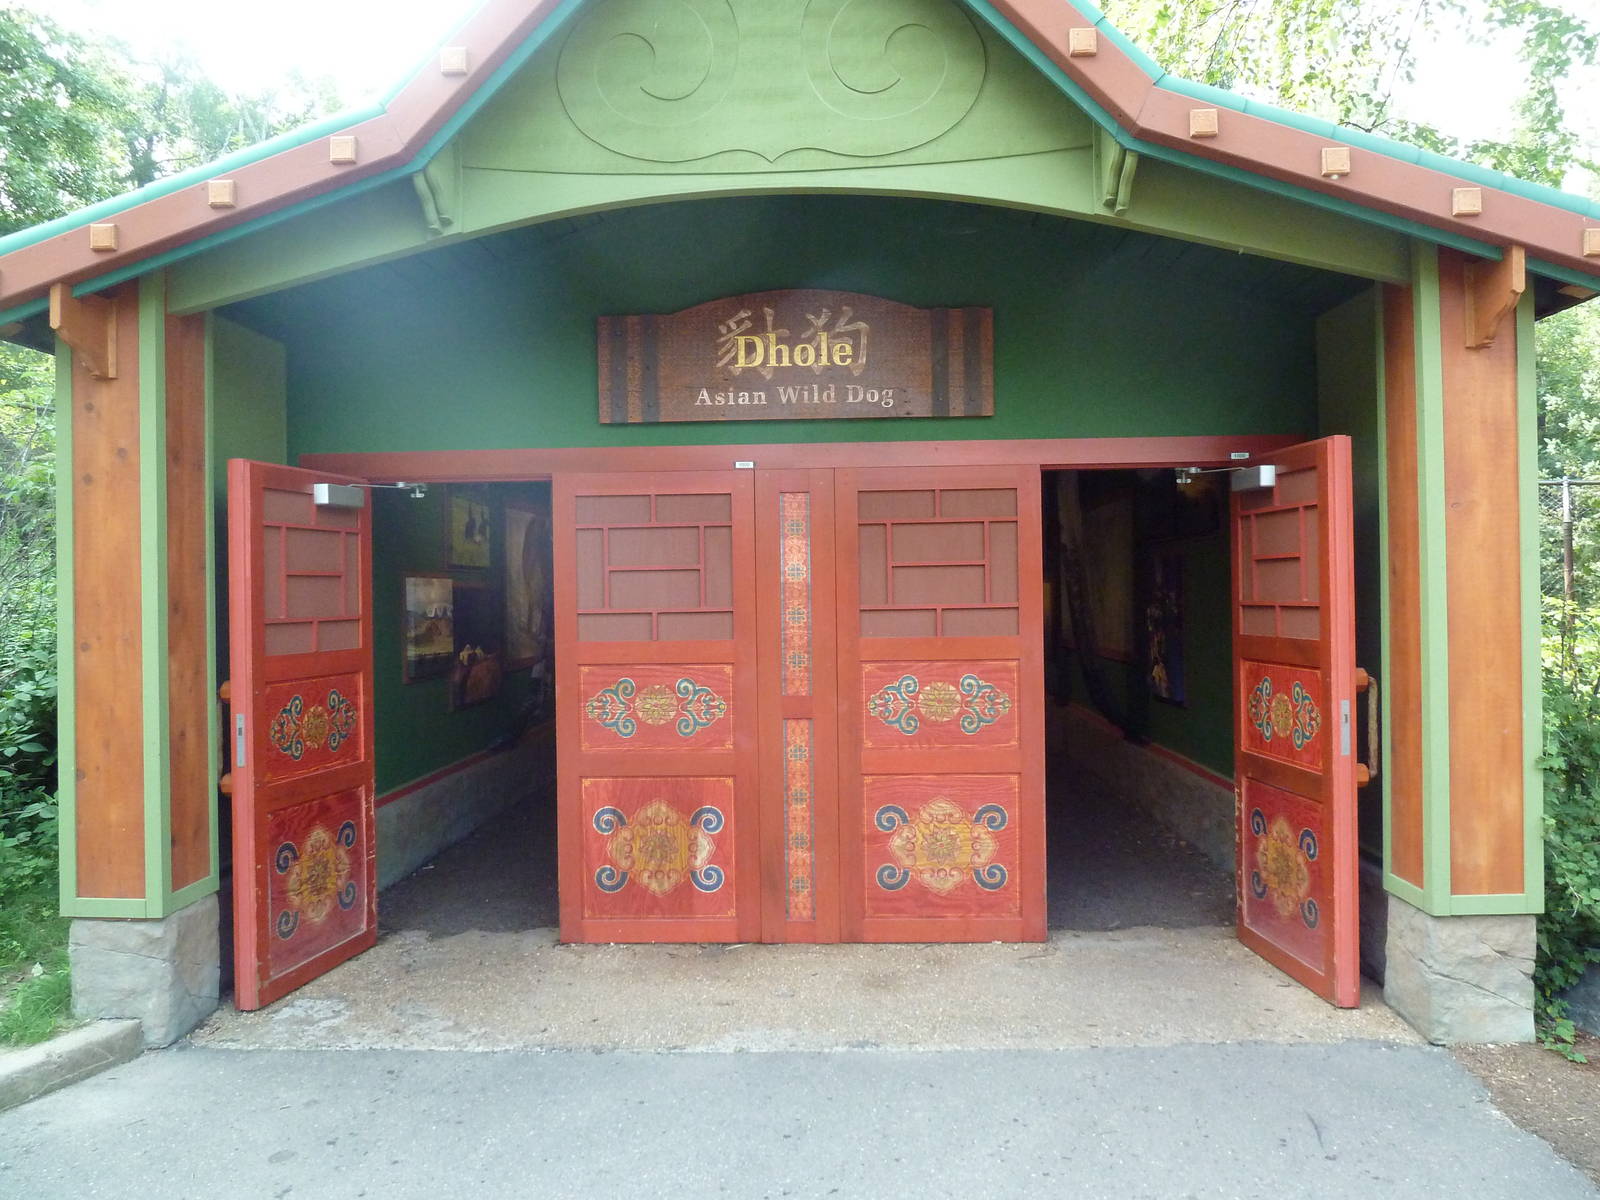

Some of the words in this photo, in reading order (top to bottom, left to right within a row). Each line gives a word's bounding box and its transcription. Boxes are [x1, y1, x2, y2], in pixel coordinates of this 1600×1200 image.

[734, 331, 853, 369] Dhole
[695, 387, 767, 406] Asian
[776, 384, 837, 404] Wild
[845, 384, 895, 408] Dog
